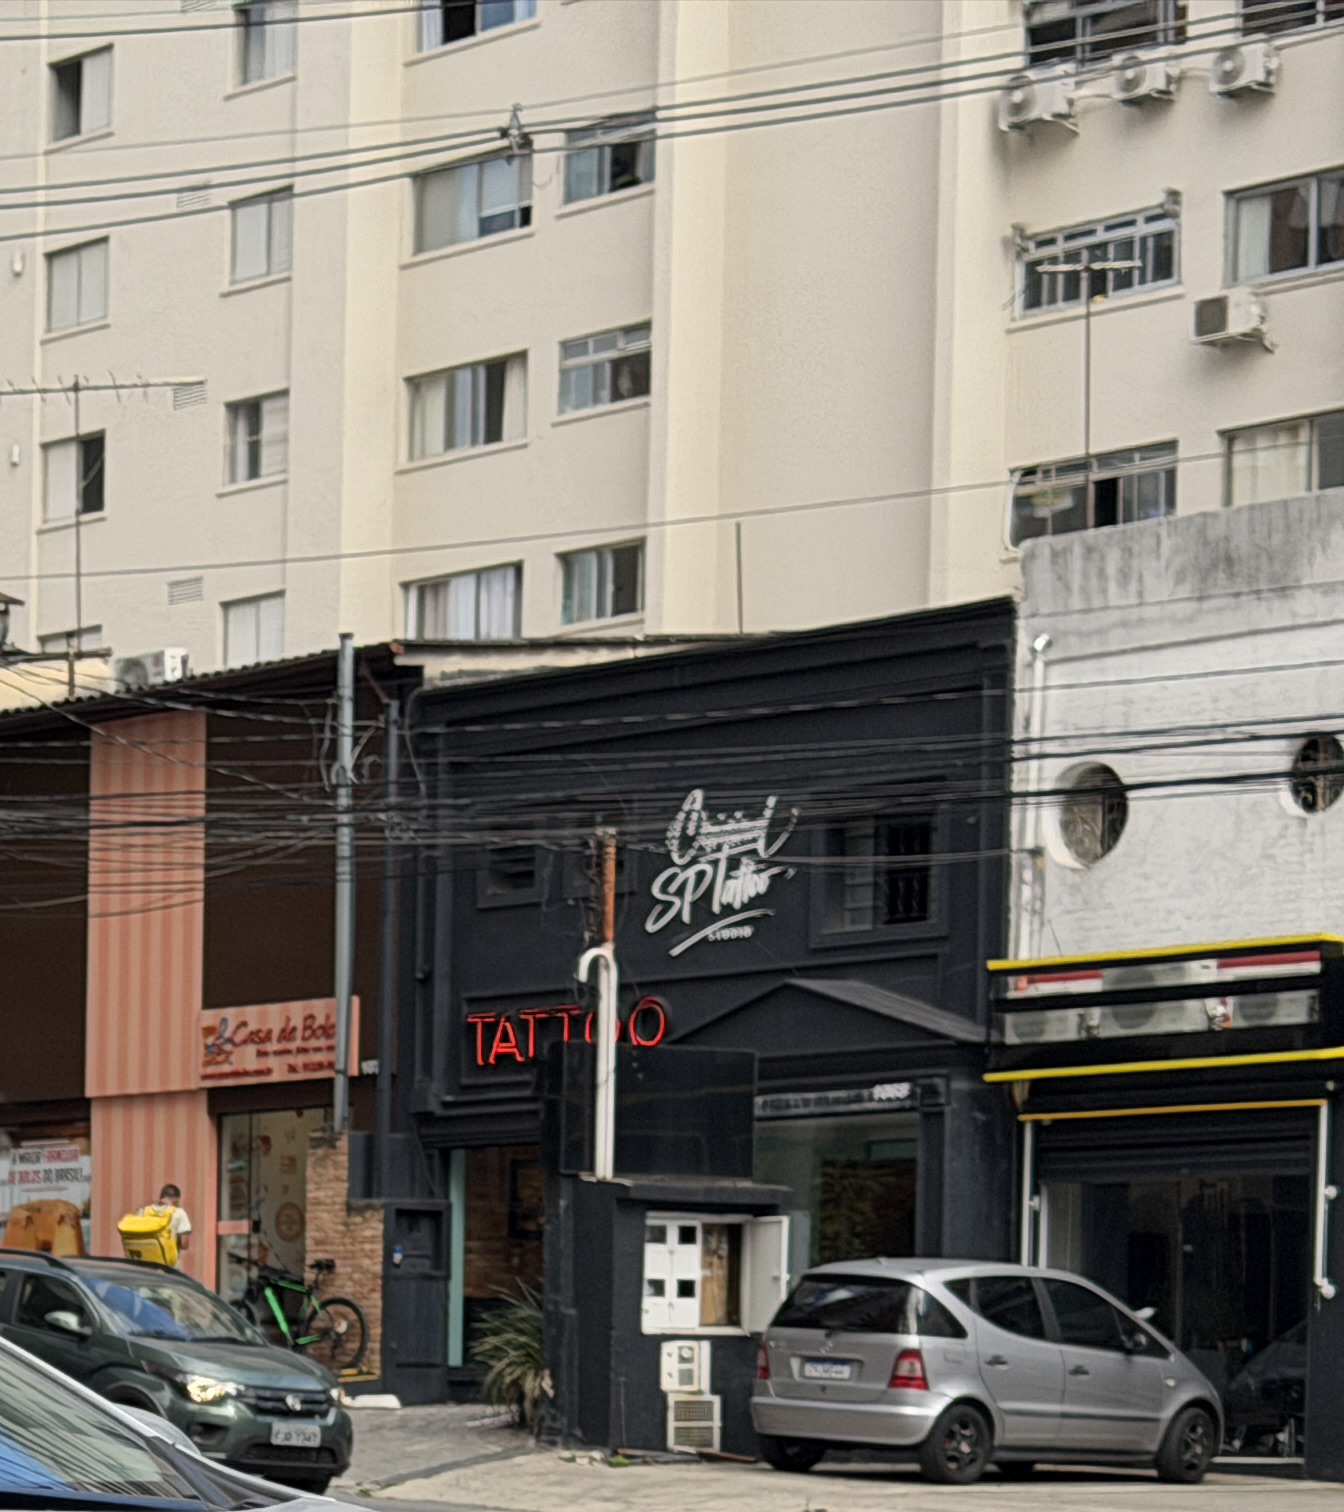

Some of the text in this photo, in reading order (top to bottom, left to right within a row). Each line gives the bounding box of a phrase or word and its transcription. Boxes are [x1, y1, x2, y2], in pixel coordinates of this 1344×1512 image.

[230, 1012, 336, 1047] Casa de Bolo
